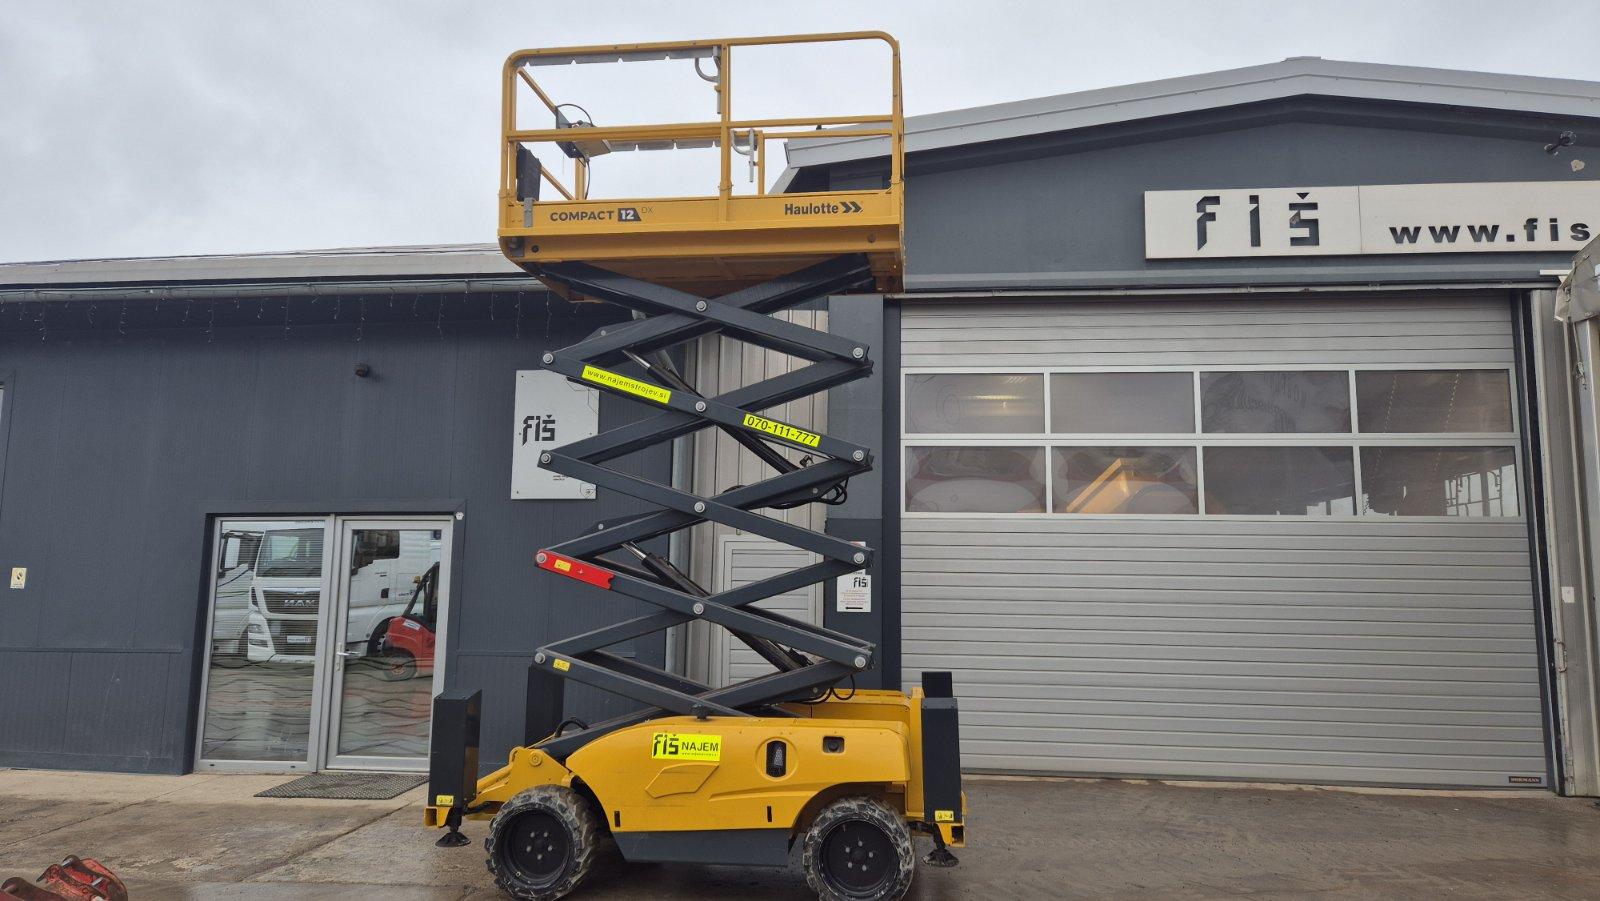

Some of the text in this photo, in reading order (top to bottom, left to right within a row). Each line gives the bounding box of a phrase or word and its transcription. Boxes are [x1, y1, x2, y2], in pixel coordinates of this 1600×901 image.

[550, 206, 655, 222] COMPACT 12 DX
[784, 203, 839, 216] Haulotte
[587, 369, 667, 399] www.najemstrojev.si
[747, 416, 817, 445] 070-111-777
[681, 741, 719, 752] NAJEM
